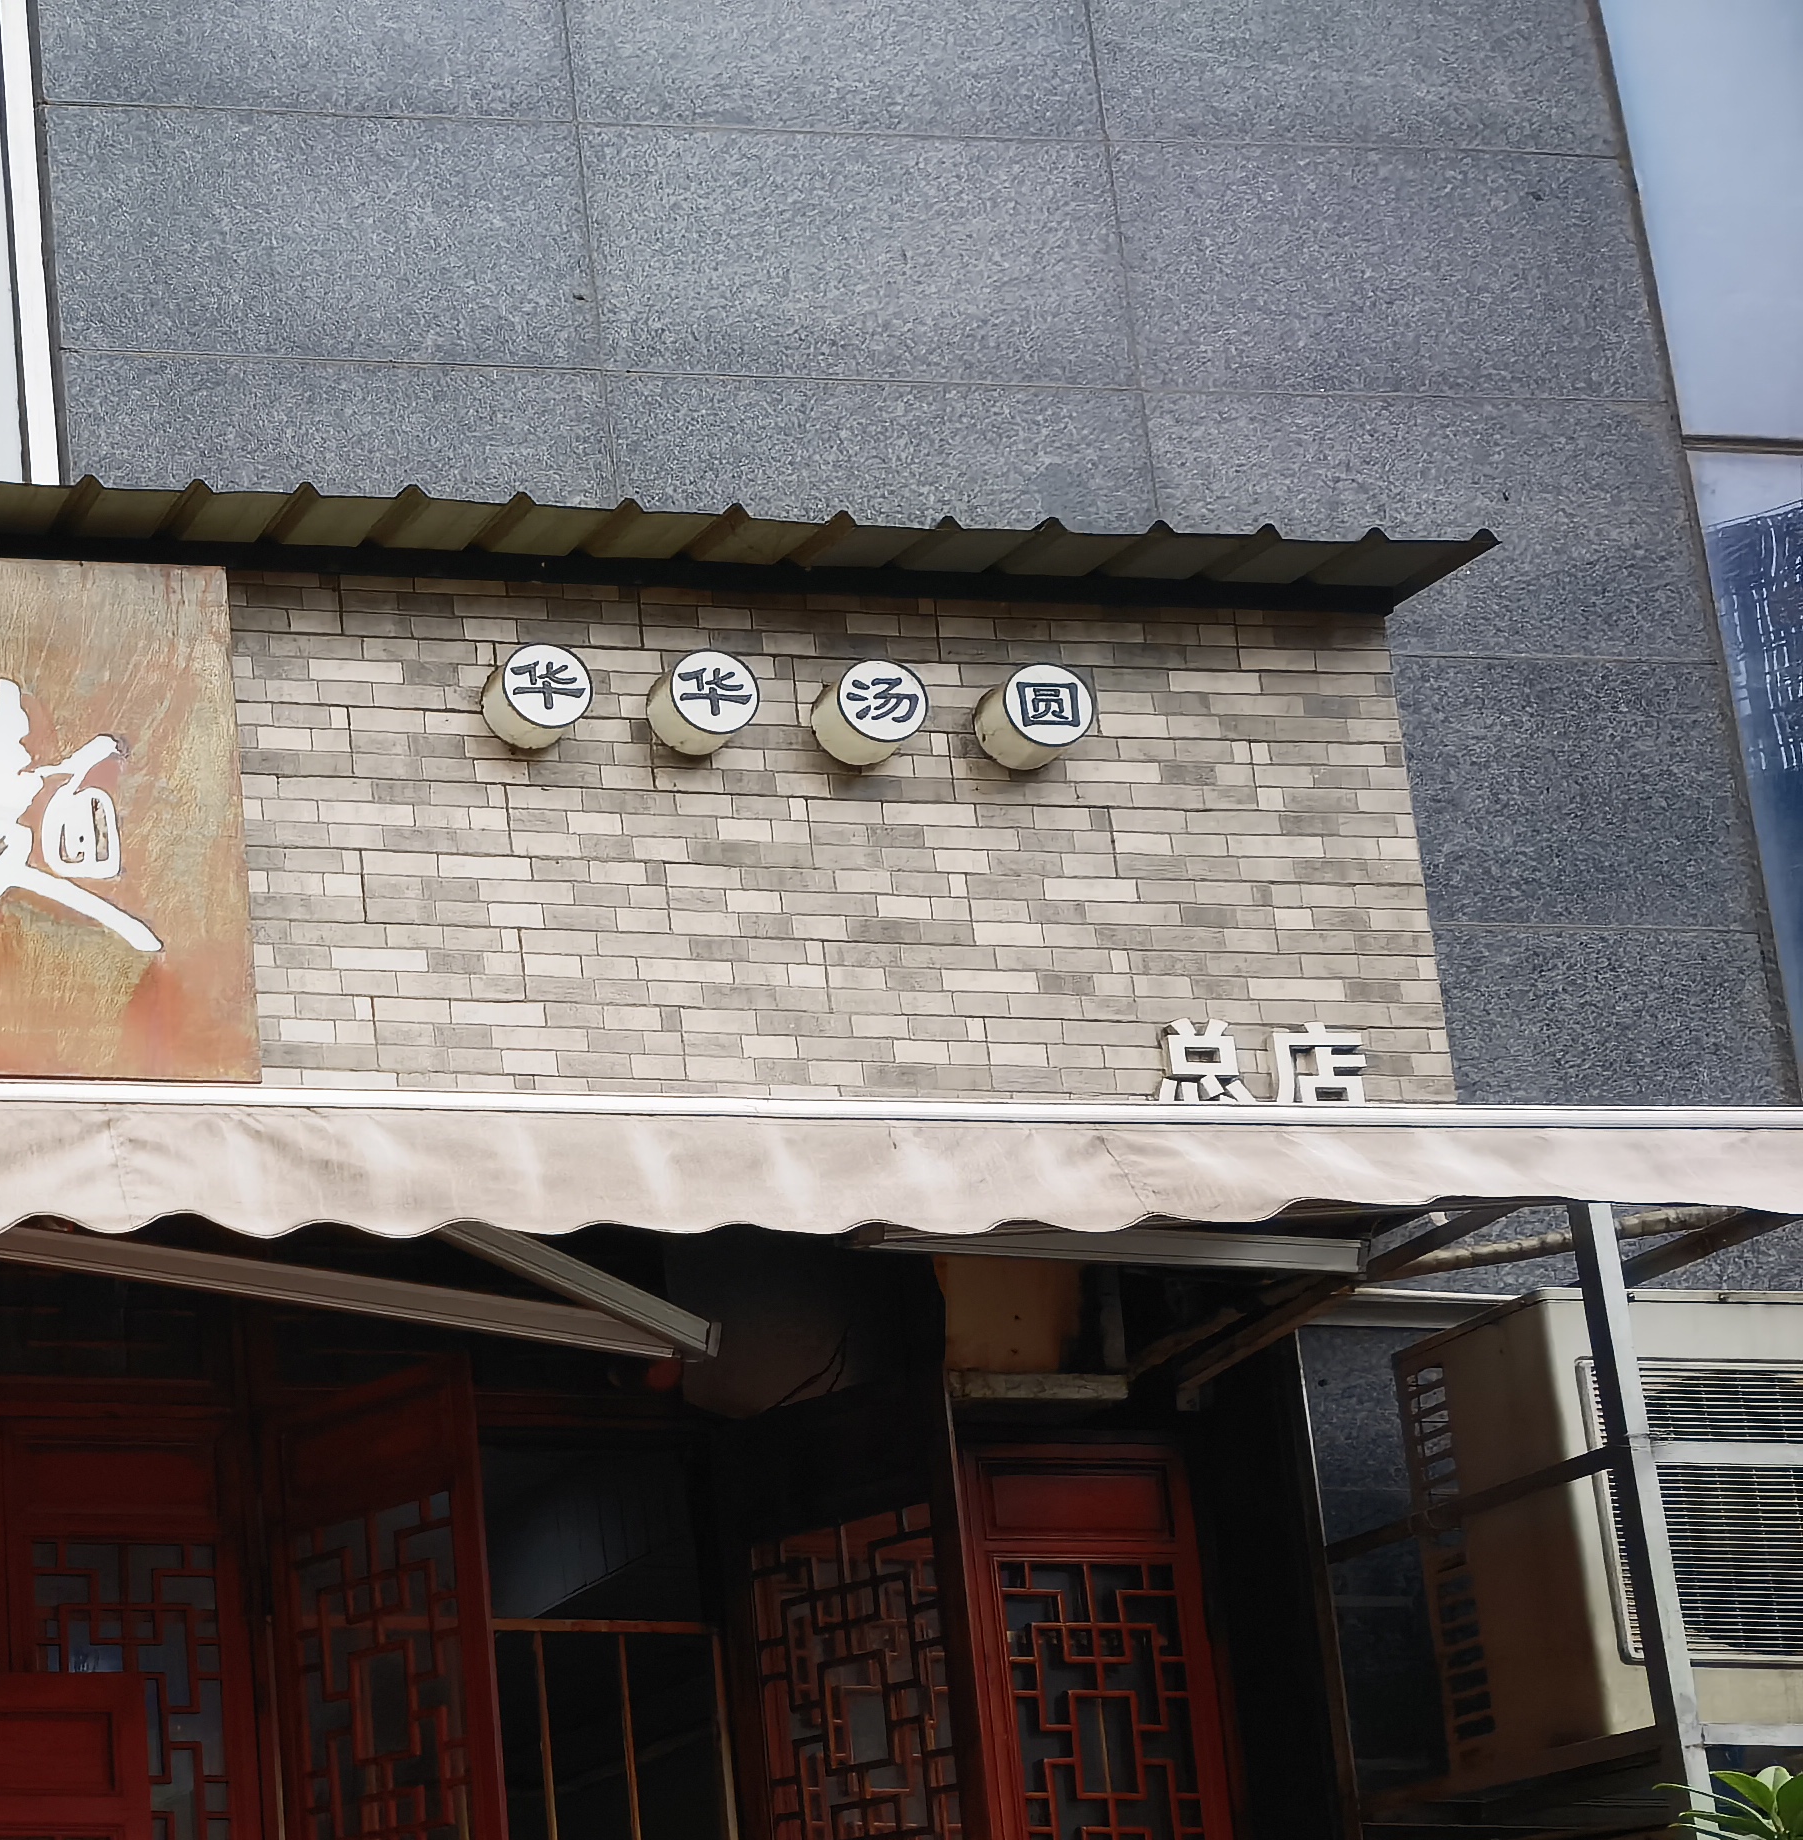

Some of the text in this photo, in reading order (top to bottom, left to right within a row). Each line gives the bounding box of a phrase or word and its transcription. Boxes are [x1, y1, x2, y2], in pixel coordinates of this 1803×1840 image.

[508, 659, 1081, 728] 华华汤圆
[1159, 1018, 1367, 1104] 总店
